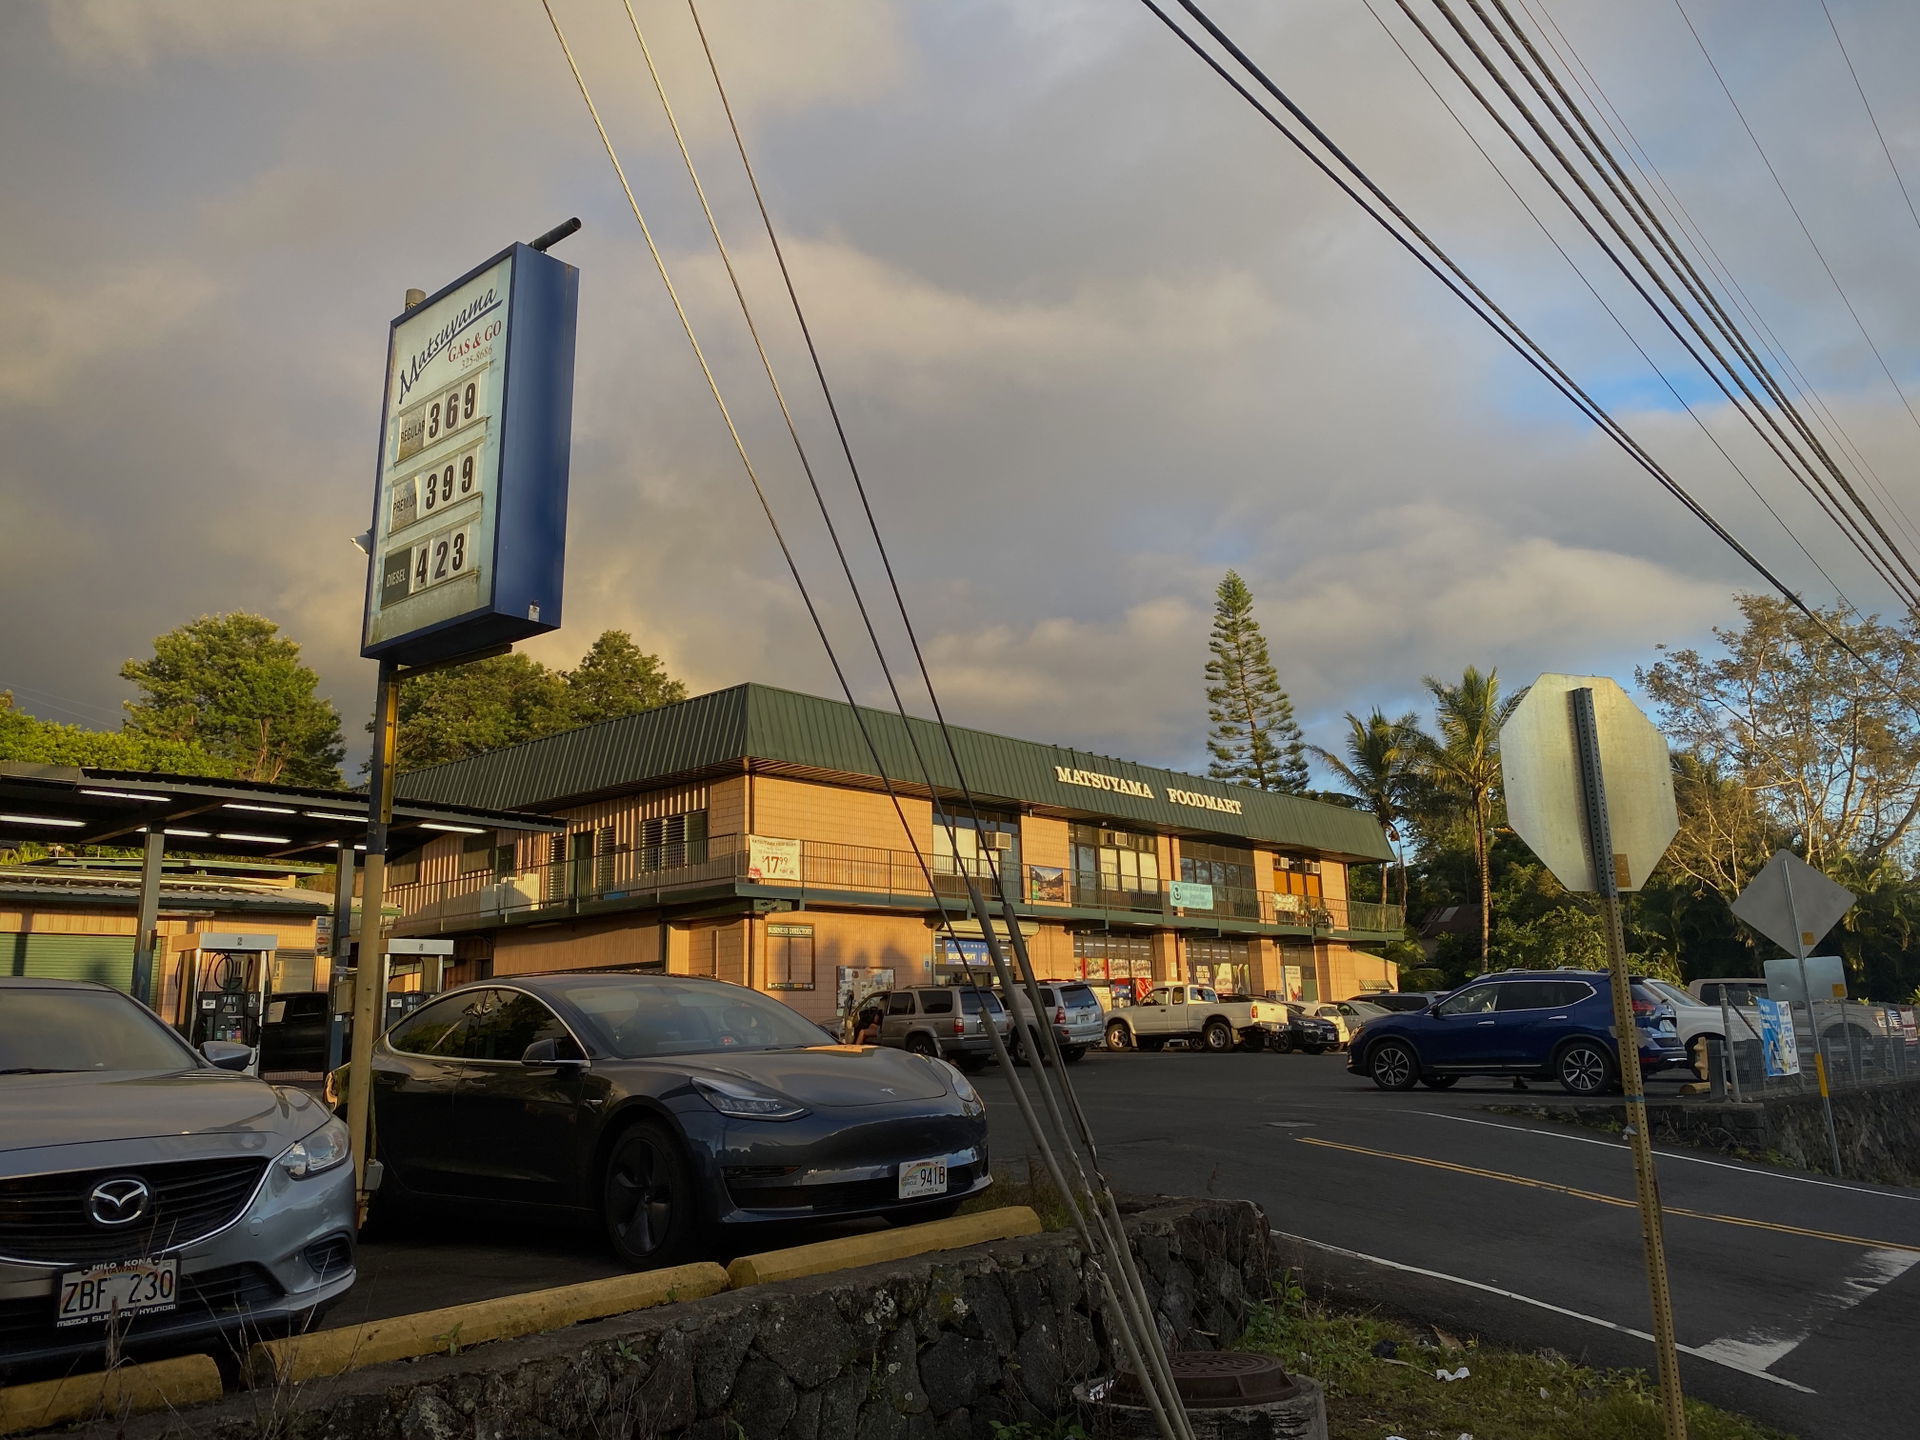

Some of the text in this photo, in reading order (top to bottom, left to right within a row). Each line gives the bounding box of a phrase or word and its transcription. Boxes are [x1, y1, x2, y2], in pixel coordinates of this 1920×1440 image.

[399, 288, 498, 404] Matsuyama
[448, 320, 502, 363] GAS & GO
[400, 382, 475, 443] REGULAR 369
[426, 455, 474, 510] 399
[386, 532, 465, 588] DIESEL 423
[1055, 766, 1243, 815] MATSUYAMA FOODMART
[920, 1166, 946, 1187] 941B
[92, 1257, 152, 1271] HILO KONA
[62, 1269, 173, 1314] ZBF 230
